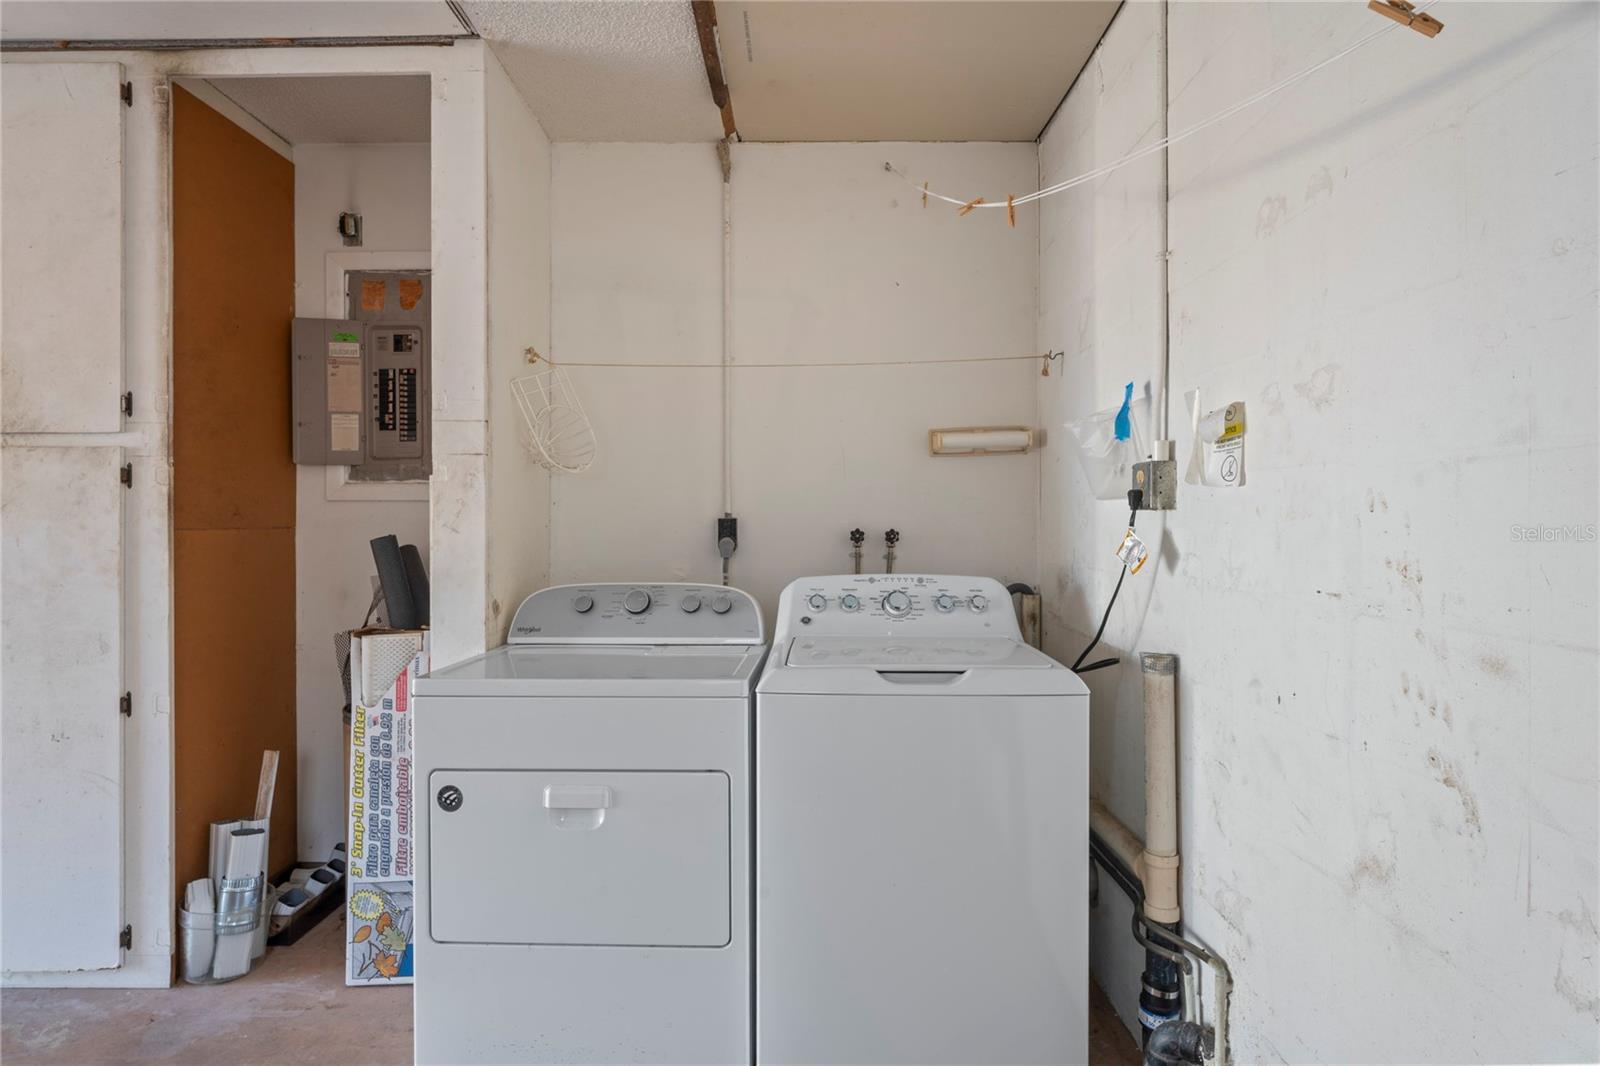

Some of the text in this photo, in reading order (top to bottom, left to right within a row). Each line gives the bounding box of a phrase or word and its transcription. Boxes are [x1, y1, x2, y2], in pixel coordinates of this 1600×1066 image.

[383, 697, 393, 710] m
[353, 704, 366, 748] Filter
[370, 735, 381, 757] con
[382, 742, 392, 759] de
[352, 749, 365, 799] Gutter
[368, 759, 380, 811] canaleta
[380, 760, 393, 807] presión
[351, 801, 365, 859] Snap-In
[369, 813, 380, 842] para
[381, 808, 391, 817] a
[366, 843, 379, 878] Filtro
[379, 818, 393, 877] enganche
[395, 837, 408, 876] Filtre
